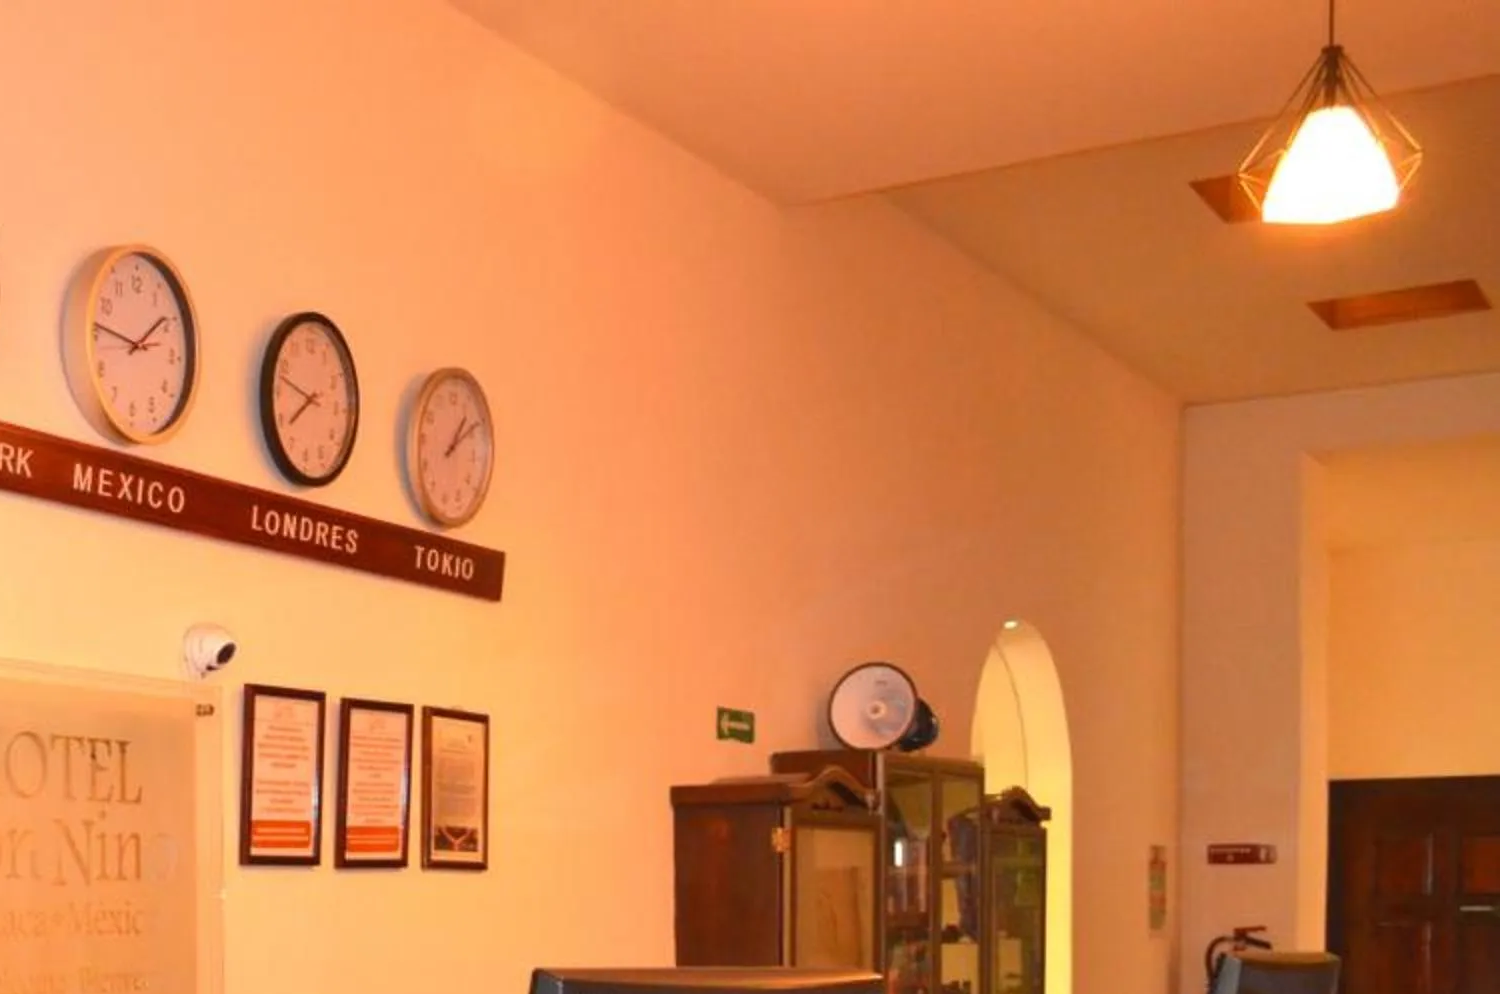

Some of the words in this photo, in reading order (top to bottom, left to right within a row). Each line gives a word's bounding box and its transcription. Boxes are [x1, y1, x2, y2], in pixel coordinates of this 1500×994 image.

[73, 463, 186, 514] MEXICO
[251, 505, 359, 554] LONDRES
[414, 545, 475, 581] TOKIO
